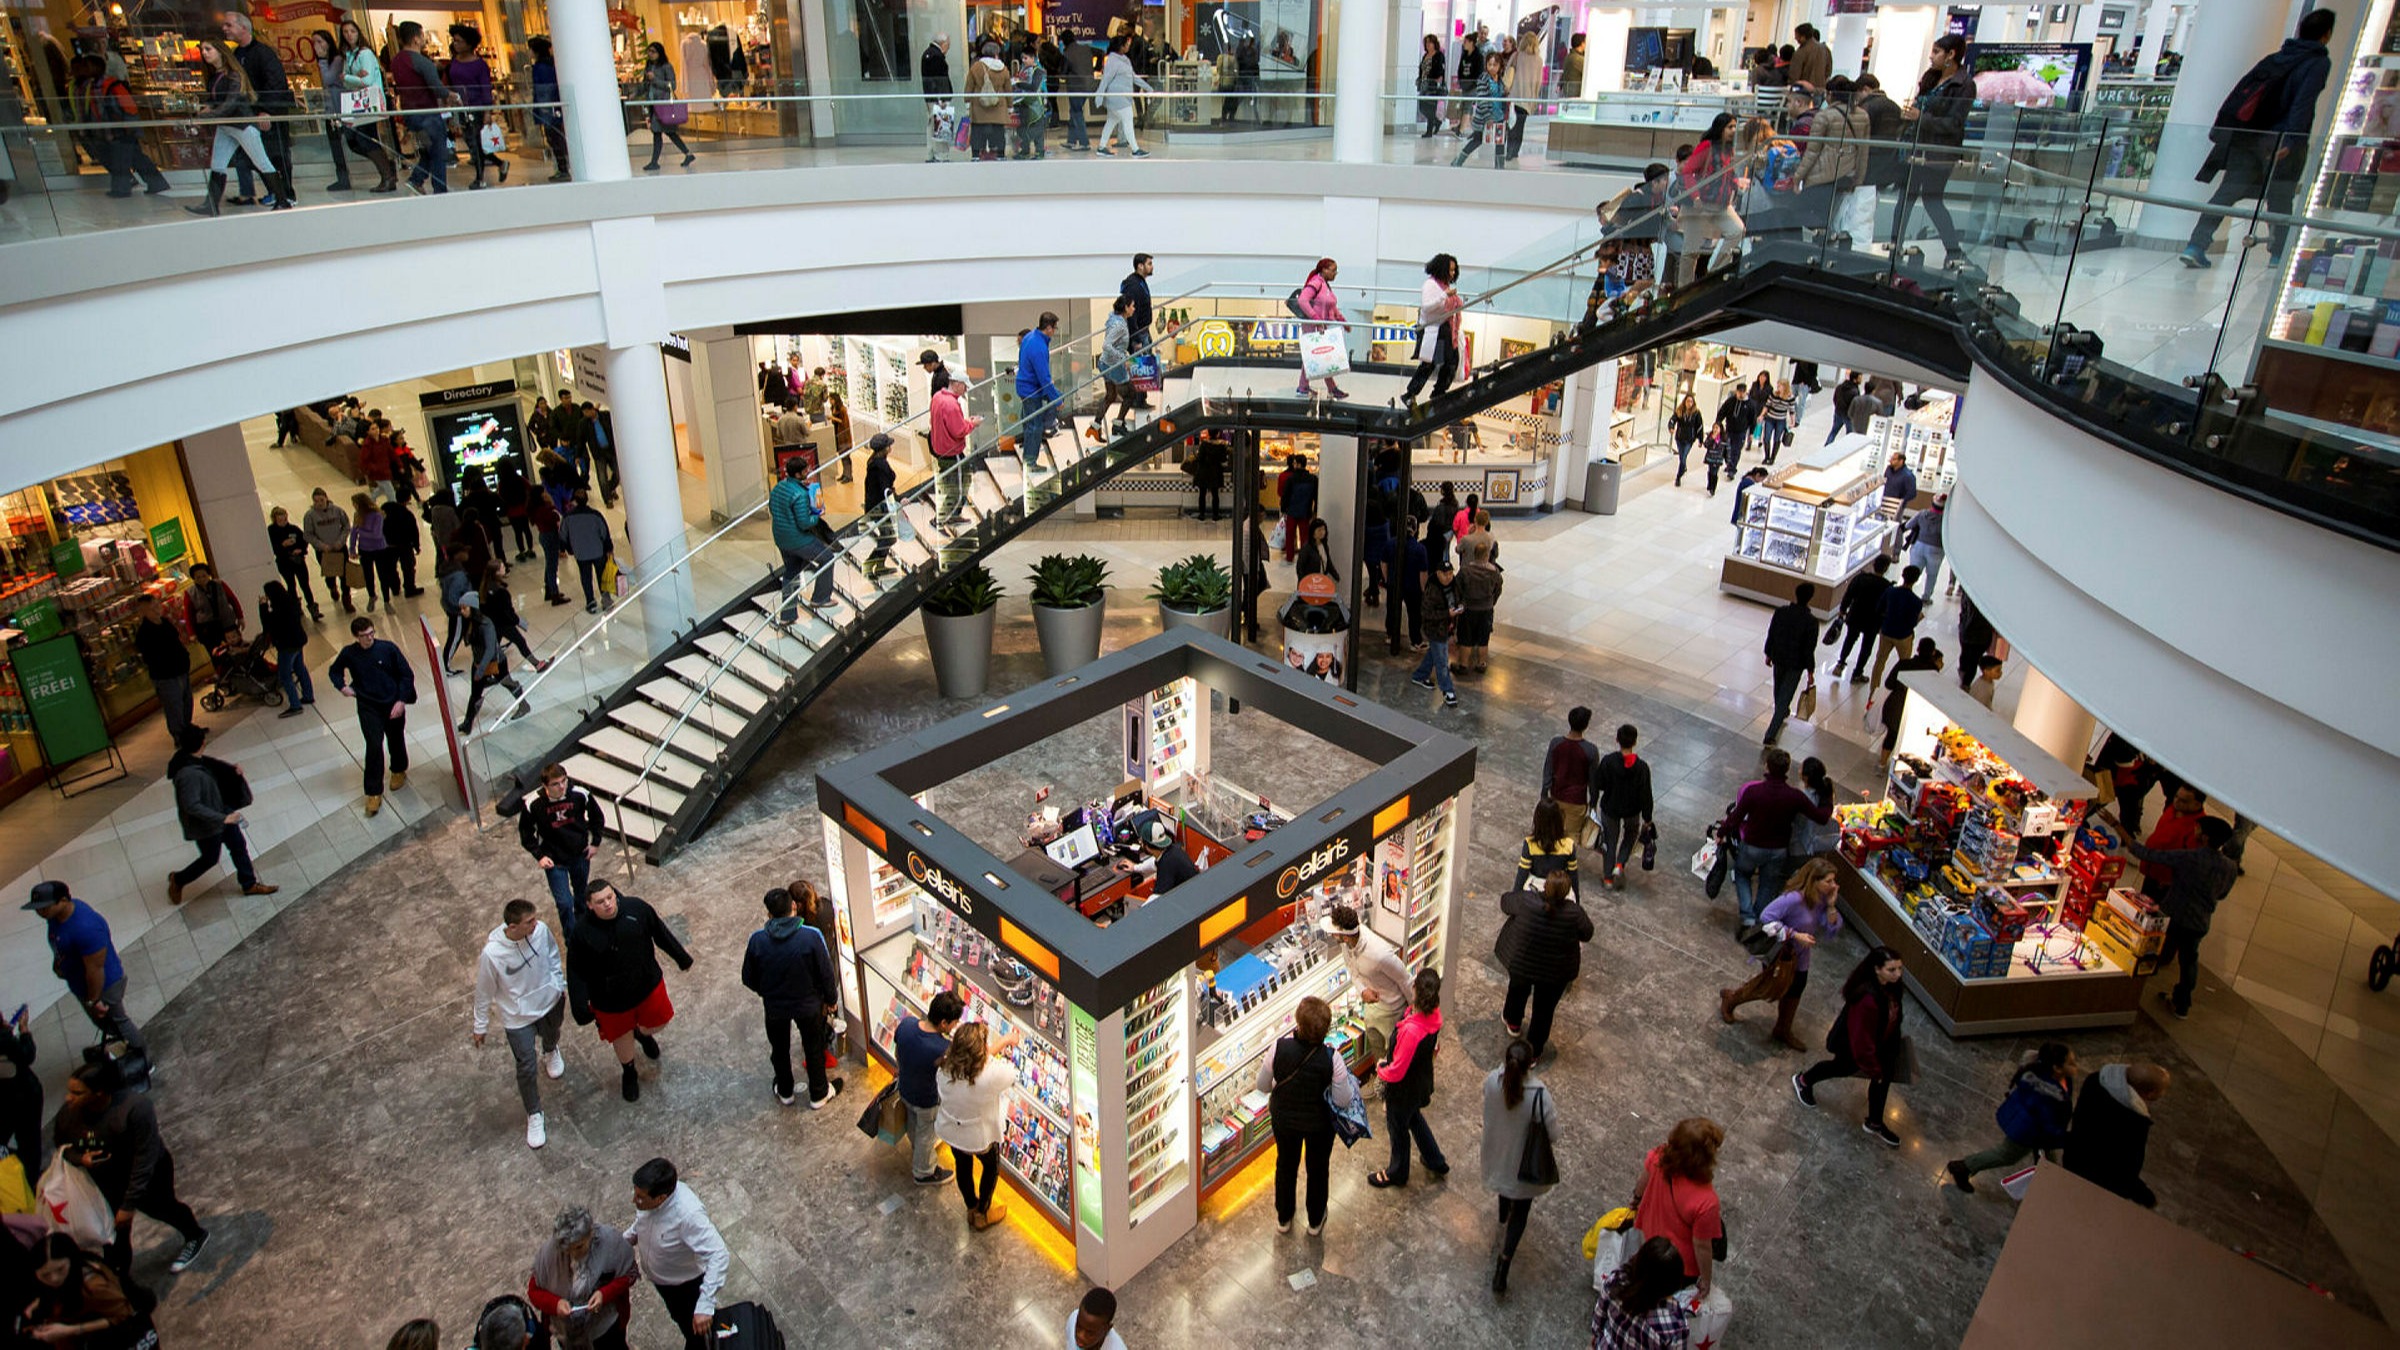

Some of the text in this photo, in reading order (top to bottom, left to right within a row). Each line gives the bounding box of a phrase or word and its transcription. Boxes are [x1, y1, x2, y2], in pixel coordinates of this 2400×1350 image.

[1056, 15, 1071, 25] your
[277, 36, 317, 63] 50
[443, 385, 493, 402] Directory
[30, 676, 77, 700] FREE!
[555, 809, 568, 821] K
[1075, 1017, 1089, 1070] DEVICE
